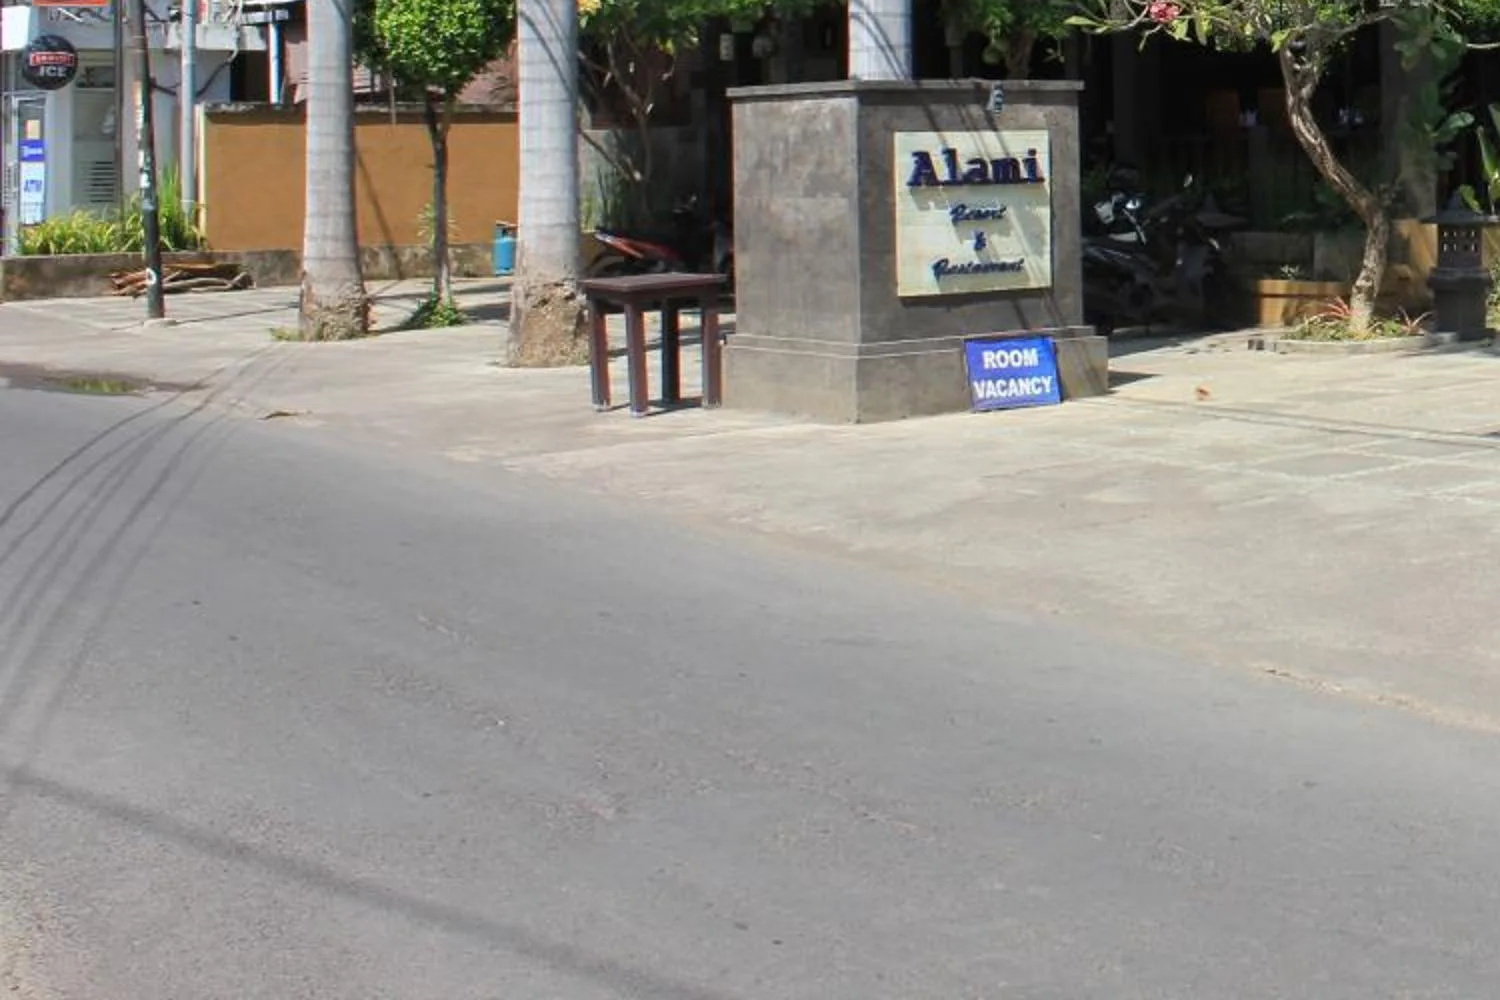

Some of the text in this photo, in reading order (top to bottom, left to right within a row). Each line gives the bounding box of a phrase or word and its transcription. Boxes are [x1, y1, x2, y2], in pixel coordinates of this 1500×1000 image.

[907, 148, 1045, 186] Alami
[949, 204, 1006, 225] Resort
[931, 258, 1025, 280] Restaurant
[982, 348, 1039, 369] ROOM
[973, 376, 1053, 399] VACANCY
